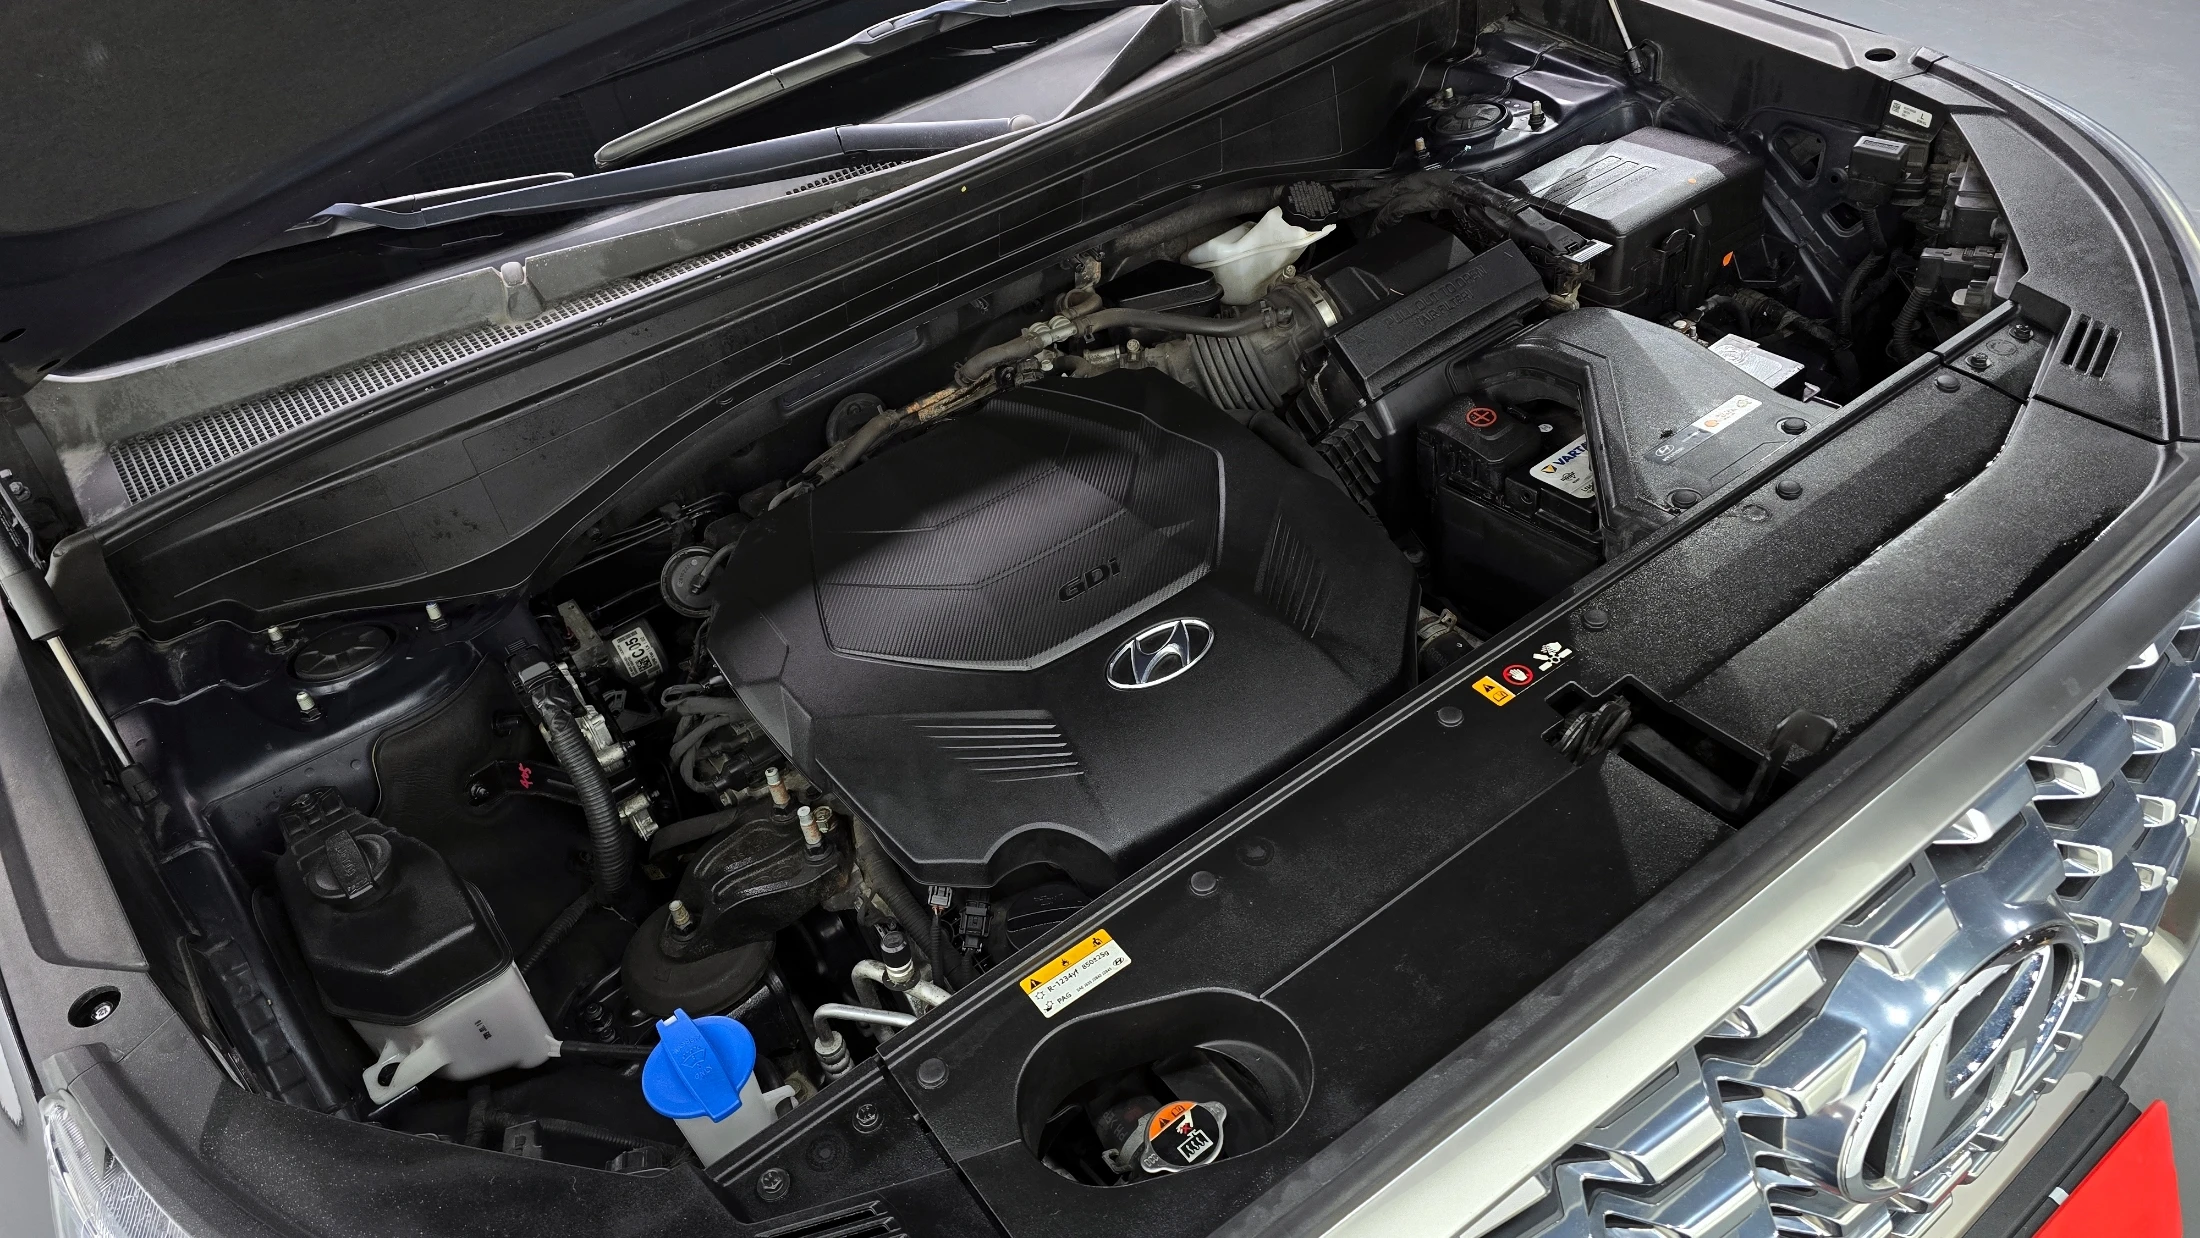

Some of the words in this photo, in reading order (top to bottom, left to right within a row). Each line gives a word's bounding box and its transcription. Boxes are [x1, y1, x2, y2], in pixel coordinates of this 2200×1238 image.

[1415, 292, 1438, 310] OUT
[1441, 281, 1456, 296] TO
[1058, 556, 1121, 603] GDi
[1047, 969, 1079, 992] R-1234yf
[1082, 950, 1110, 969] 850±25g
[1057, 992, 1072, 1005] PAG
